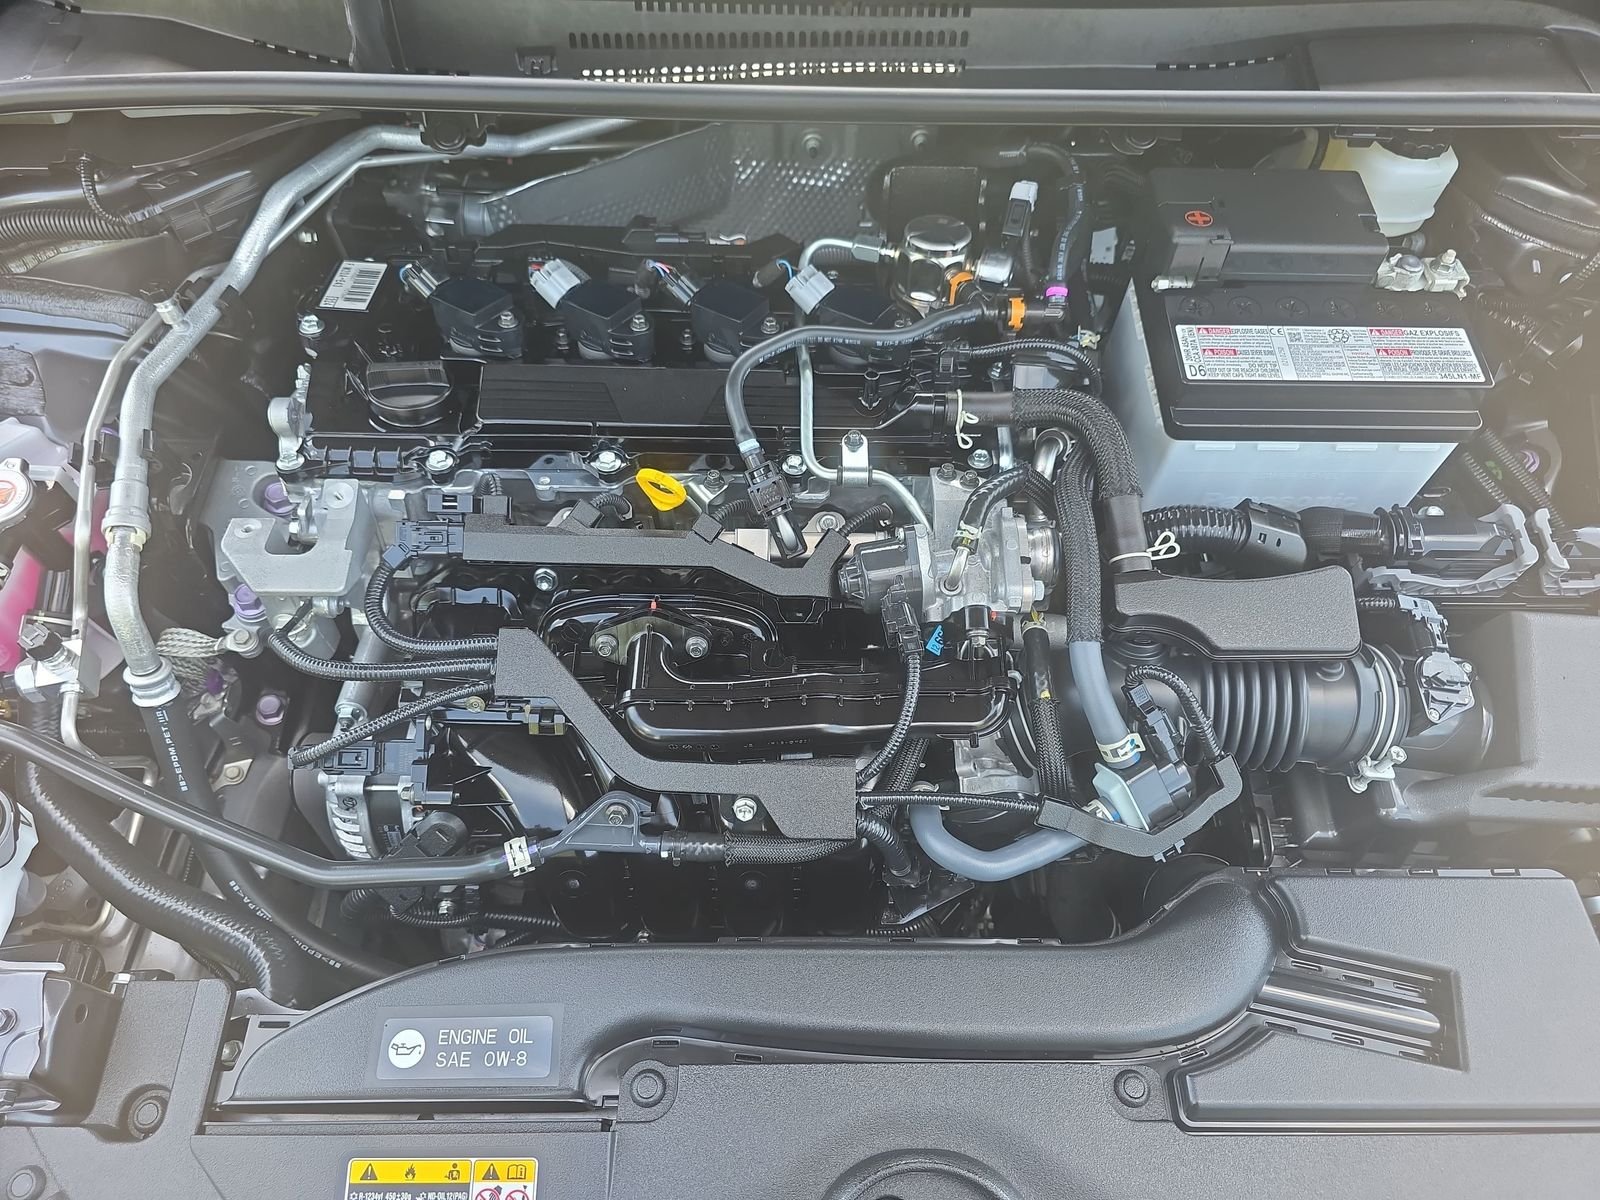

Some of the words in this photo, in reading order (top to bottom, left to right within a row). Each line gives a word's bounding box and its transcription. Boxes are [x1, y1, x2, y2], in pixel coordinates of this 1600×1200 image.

[1269, 327, 1284, 336] CE
[1420, 329, 1460, 337] EXPLOSIFS
[1213, 348, 1234, 356] POISON
[1189, 365, 1206, 377] D6
[438, 1029, 498, 1045] ENGINE
[508, 1028, 534, 1044] OIL
[435, 1051, 472, 1067] SAE
[484, 1050, 528, 1067] 0W-8
